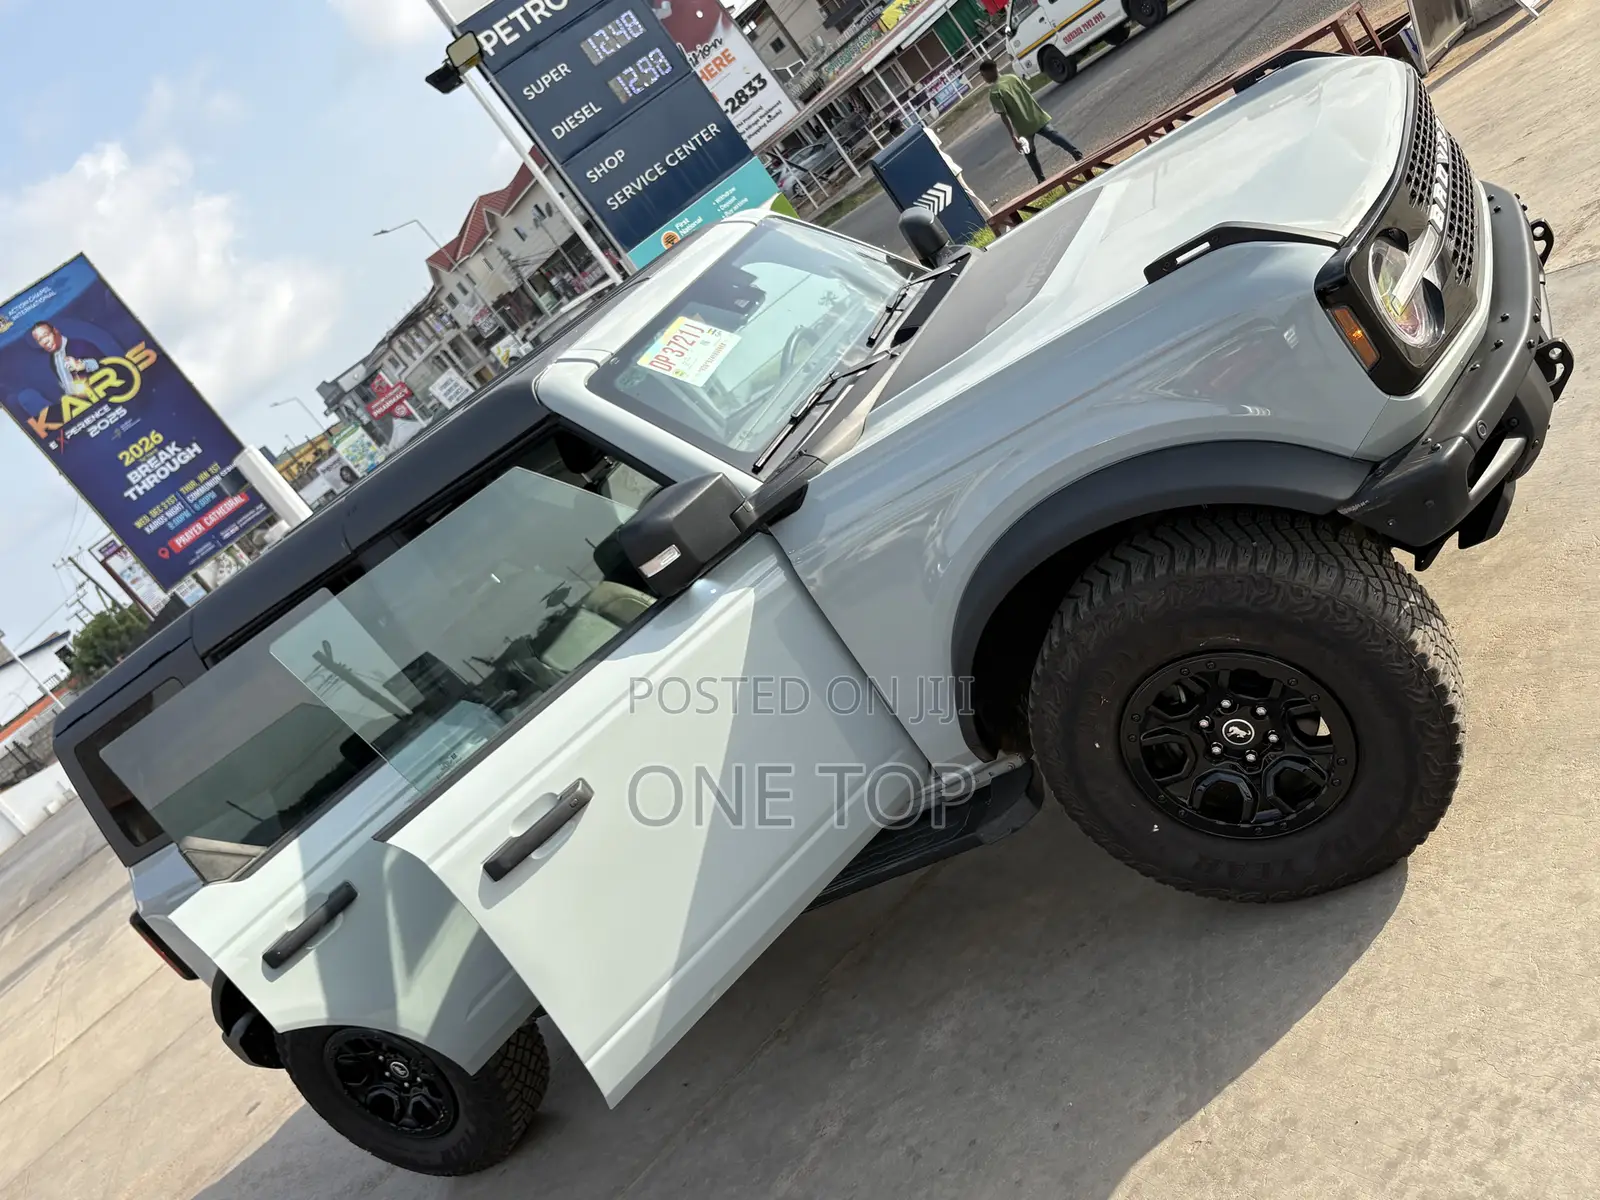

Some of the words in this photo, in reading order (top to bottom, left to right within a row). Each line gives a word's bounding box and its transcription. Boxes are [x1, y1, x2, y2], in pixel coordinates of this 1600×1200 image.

[522, 62, 572, 101] SUPER
[550, 101, 602, 140] DIESEL
[585, 149, 626, 184] SHOP
[606, 163, 667, 211] SERVICE
[664, 123, 721, 169] CENTER
[674, 217, 690, 230] First
[679, 215, 704, 237] National
[87, 405, 128, 438] 2025
[118, 430, 164, 467] 2026
[126, 441, 182, 485] BREAK
[124, 442, 202, 501] THROUGH
[186, 474, 222, 503] COMMUNION
[144, 514, 168, 535] KAIROS
[165, 501, 185, 519] NIGHT
[175, 522, 205, 548] PRAYER
[204, 494, 245, 527] CATHEDRAL
